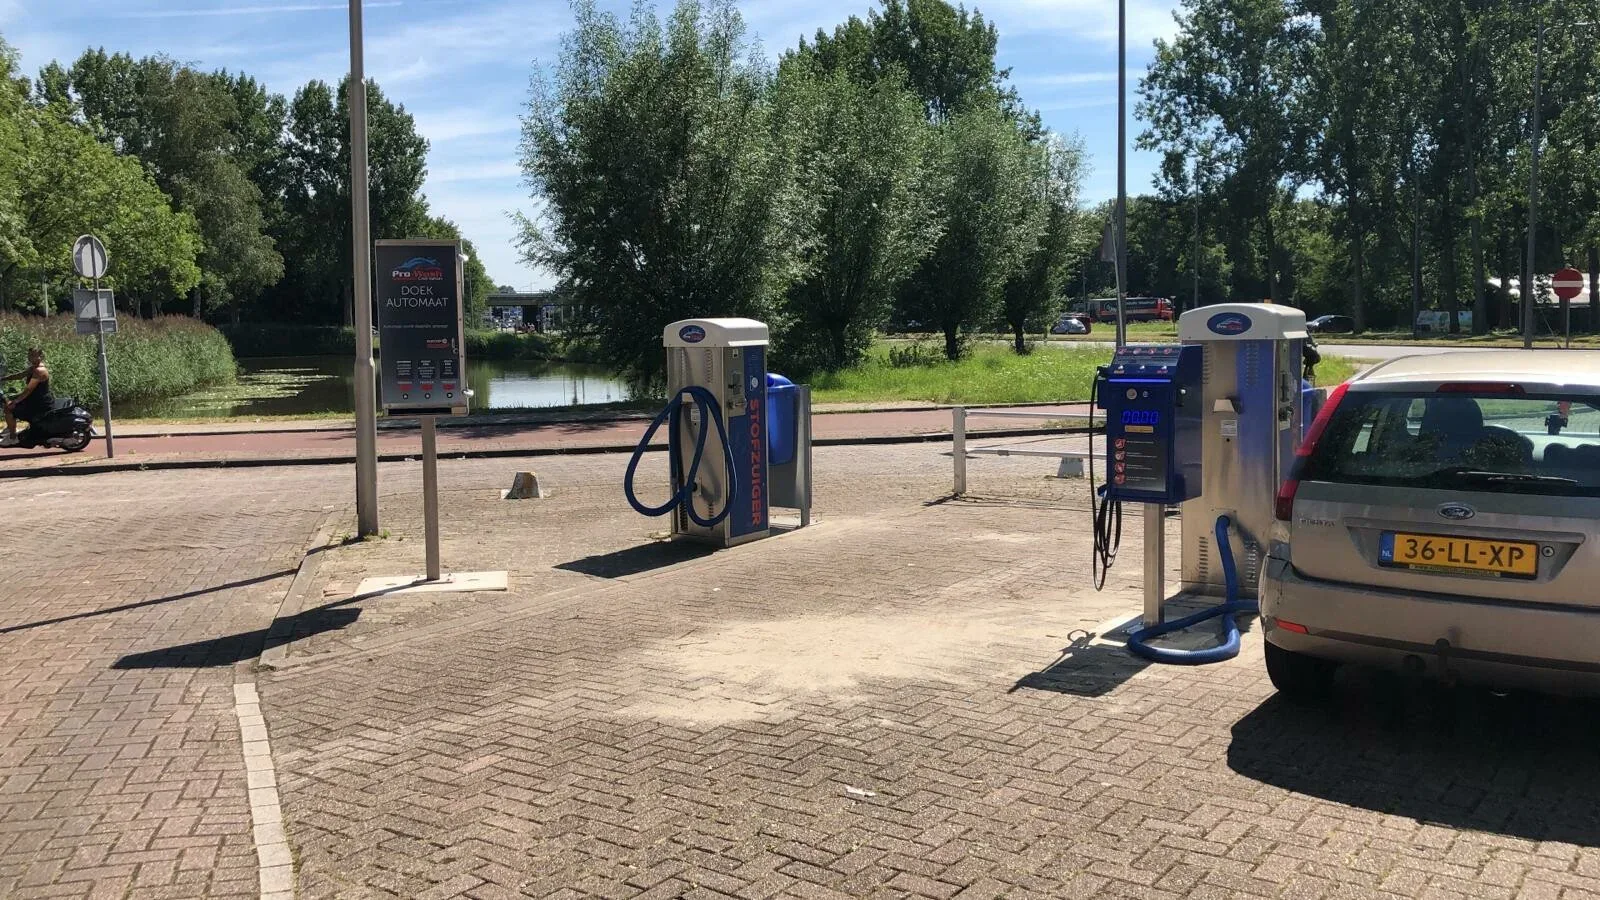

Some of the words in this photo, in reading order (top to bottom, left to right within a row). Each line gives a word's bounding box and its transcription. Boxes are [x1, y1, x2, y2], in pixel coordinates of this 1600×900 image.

[392, 270, 411, 278] Pro
[401, 285, 434, 296] DOEK
[386, 297, 449, 308] AUTOMAAT
[750, 399, 762, 526] STOFZUIGER
[1381, 549, 1392, 557] NL
[1404, 538, 1525, 567] 36-LL-XP
